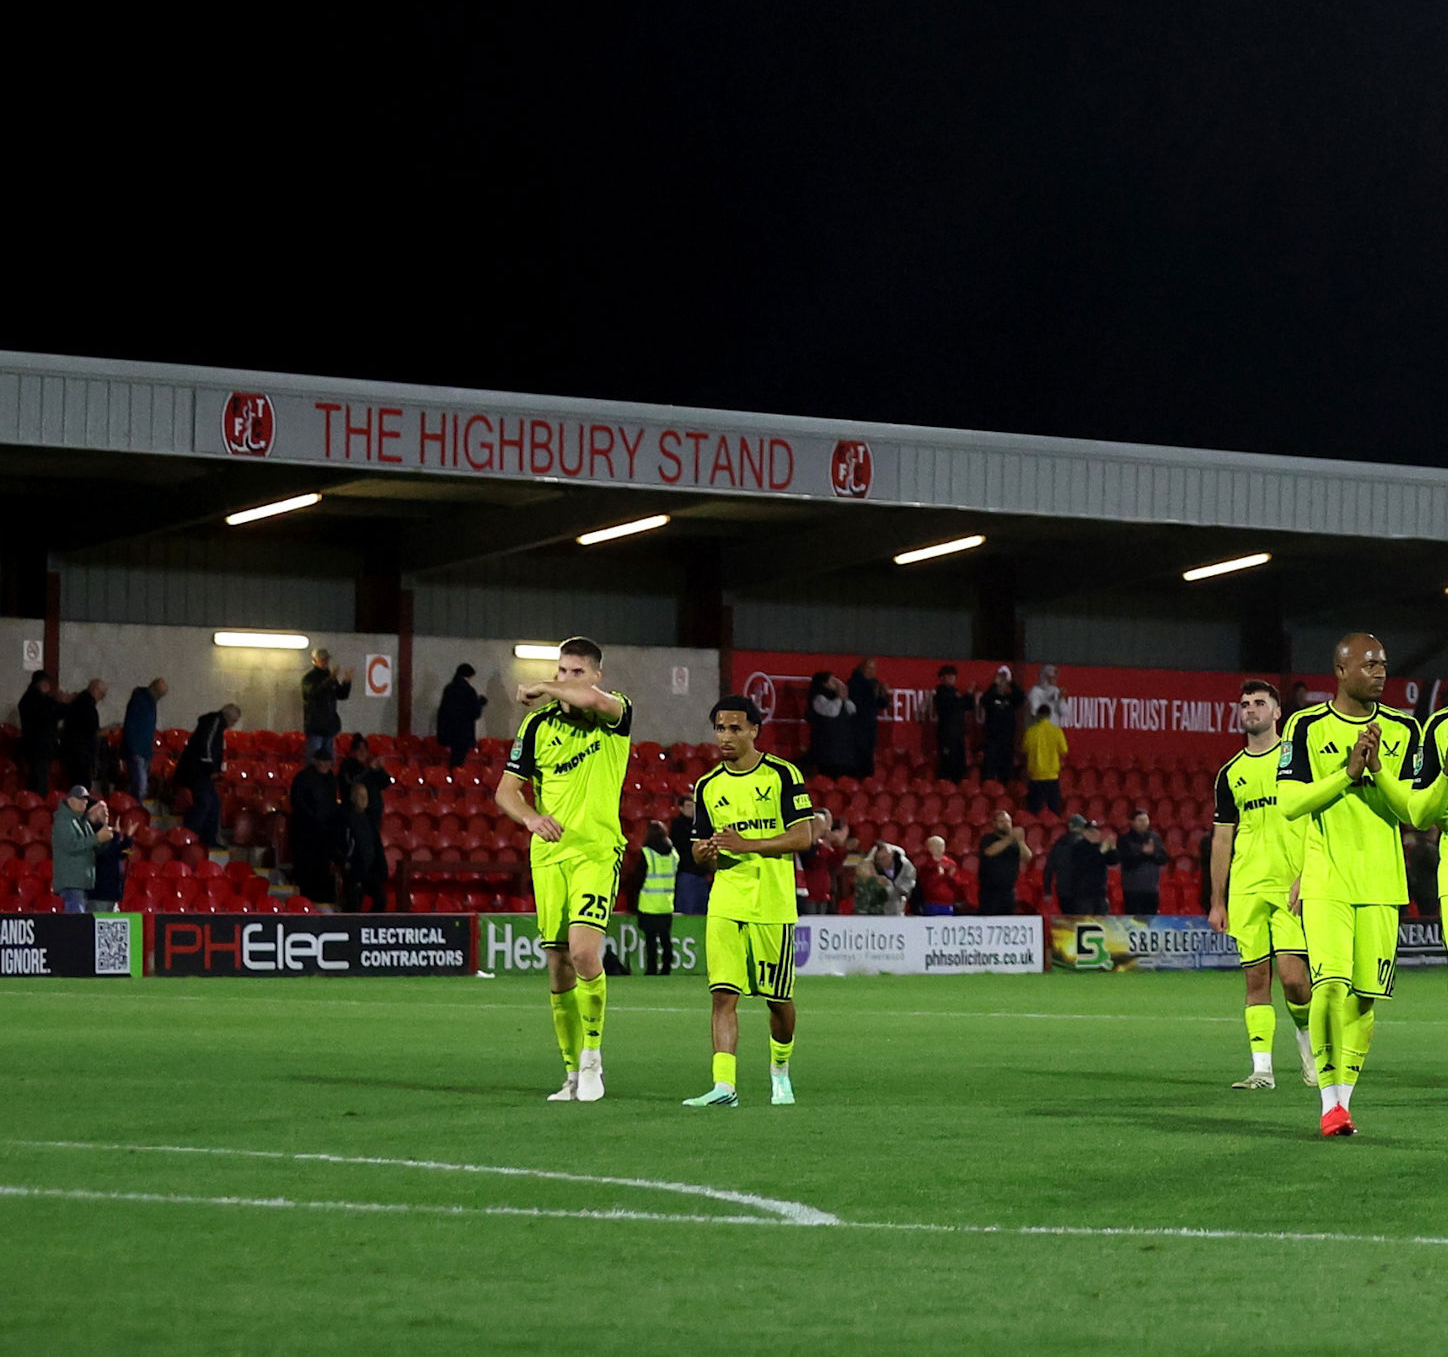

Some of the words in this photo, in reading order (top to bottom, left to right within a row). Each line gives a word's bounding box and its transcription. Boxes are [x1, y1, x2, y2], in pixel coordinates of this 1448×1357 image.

[315, 403, 402, 463] THE
[419, 411, 644, 479] HIGHBURY
[658, 429, 794, 490] STAND
[368, 656, 389, 694] C
[1120, 698, 1170, 731] TRUST
[1172, 700, 1227, 733] FAMILY
[578, 893, 609, 920] 25
[360, 927, 447, 945] ELECTRICAL
[818, 928, 906, 951] Solicitors
[942, 926, 984, 946] 01253
[987, 926, 1034, 946] 778231
[1129, 931, 1159, 953] S&B
[1164, 931, 1237, 954] ELECTRIC
[1399, 923, 1442, 945] NERAL
[1, 948, 51, 974] IGNORE.
[360, 950, 464, 967] CONTRACTORS
[925, 949, 1034, 971] phhsolicitors.co.uk
[758, 960, 778, 988] 11
[1377, 957, 1392, 986] 10
